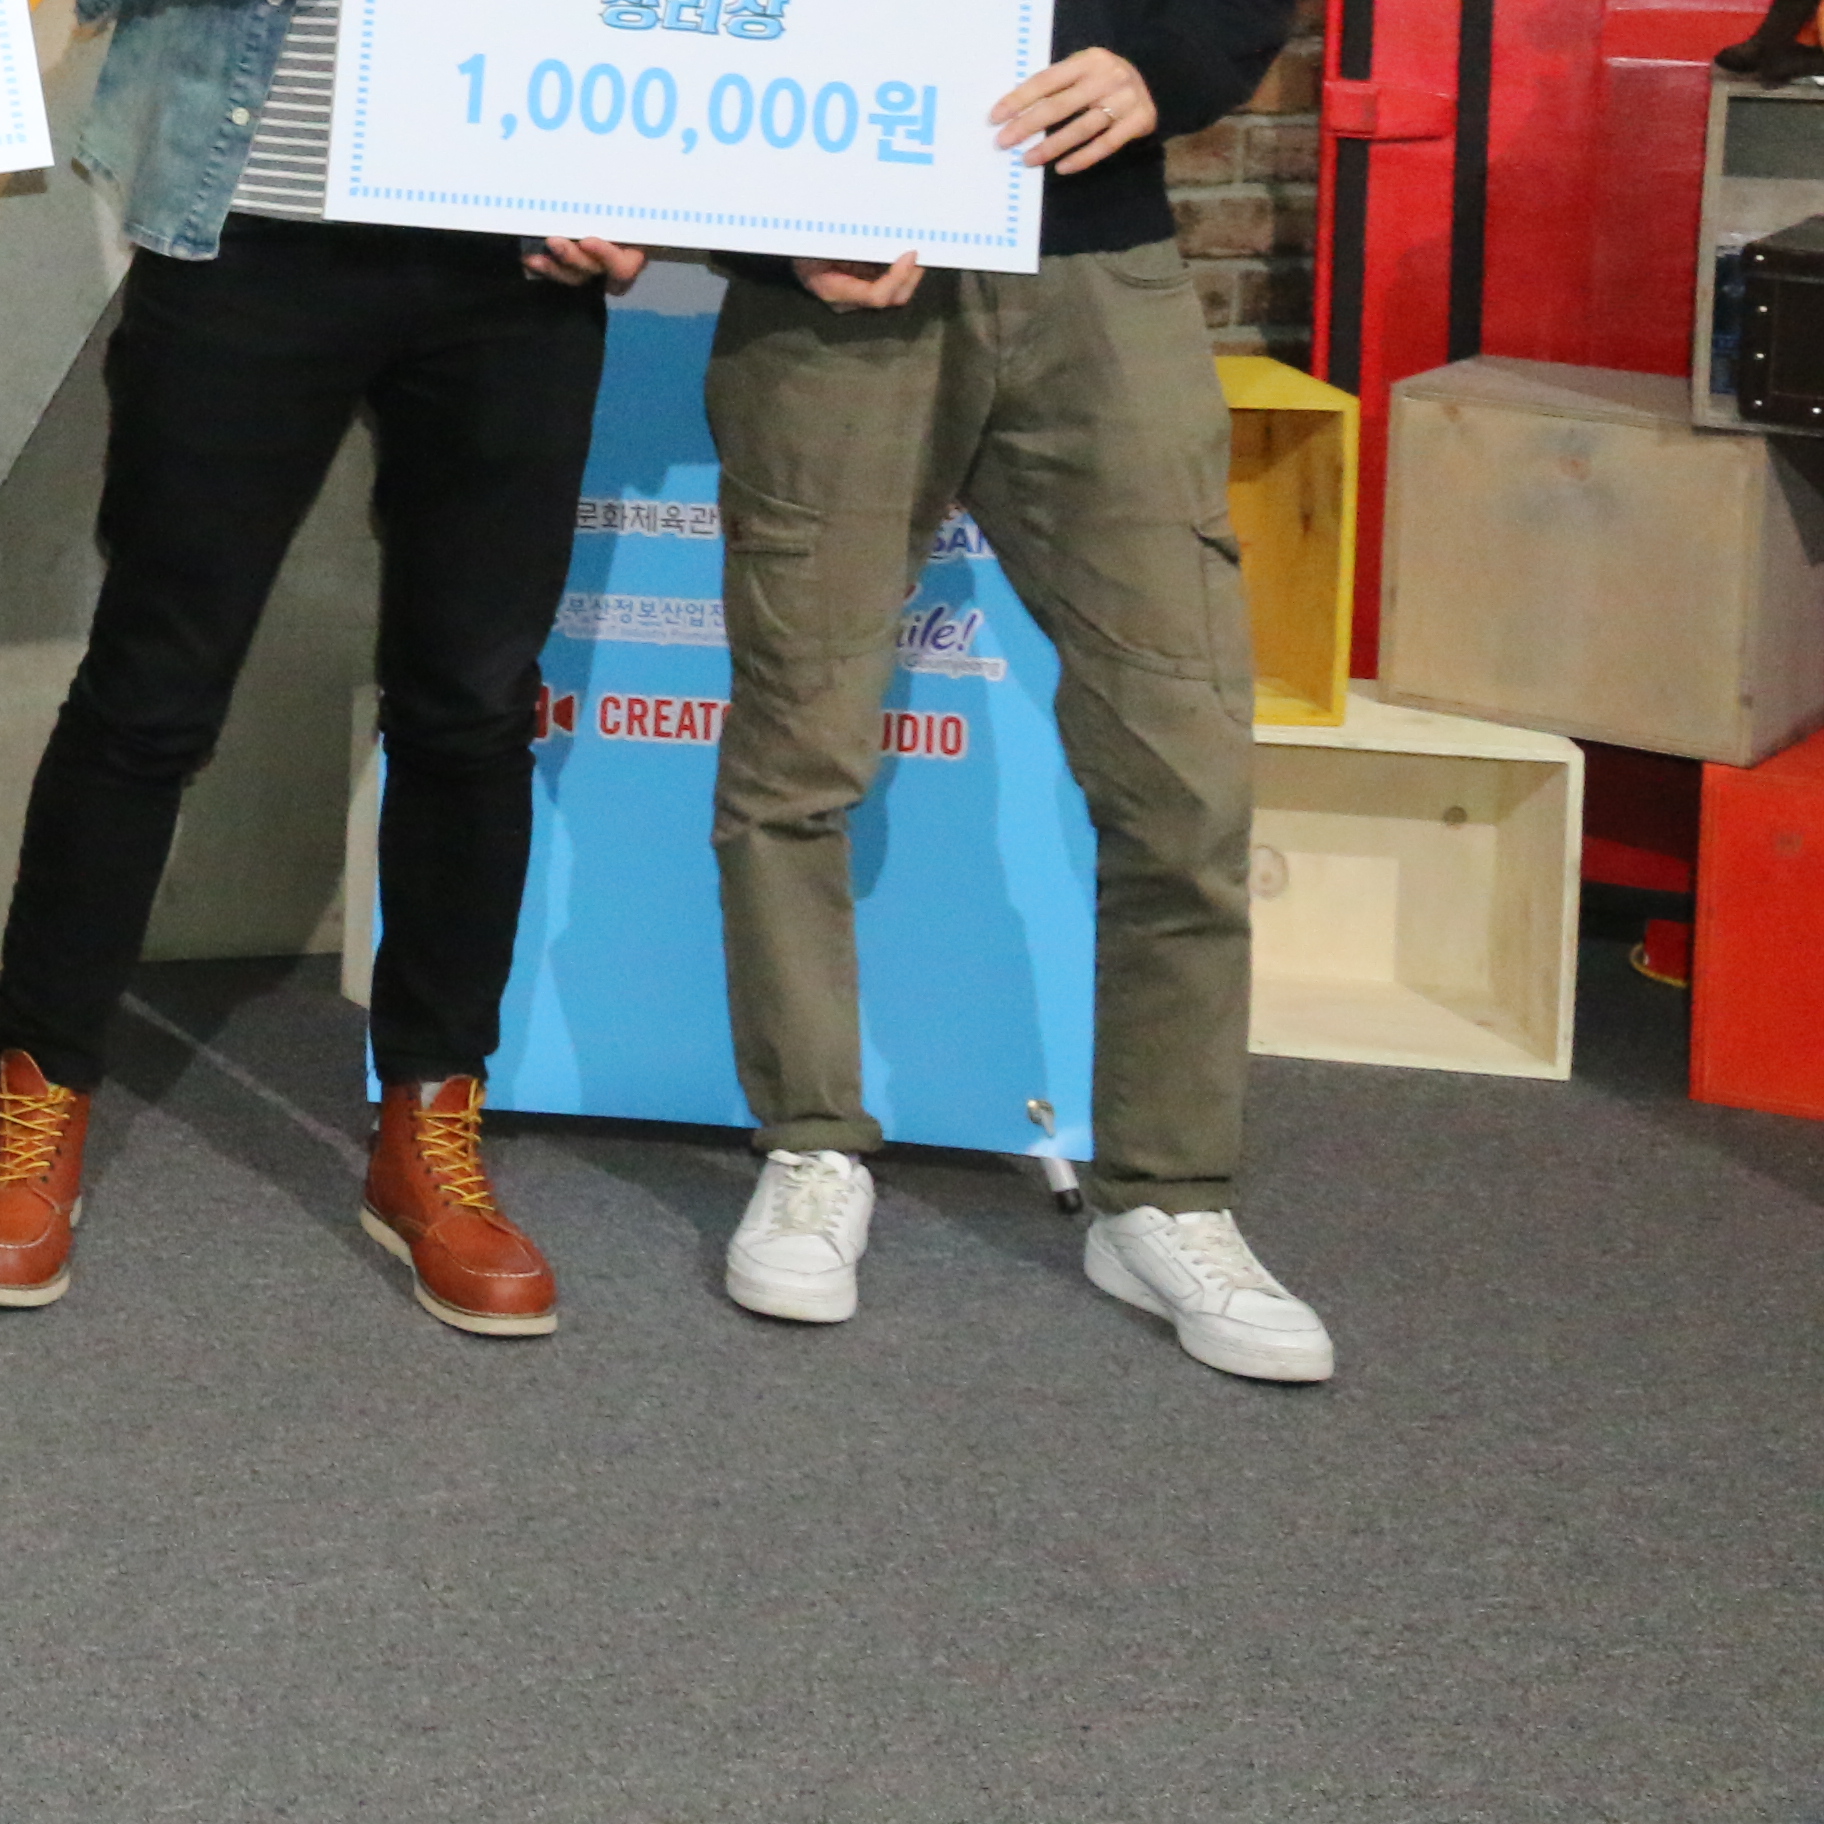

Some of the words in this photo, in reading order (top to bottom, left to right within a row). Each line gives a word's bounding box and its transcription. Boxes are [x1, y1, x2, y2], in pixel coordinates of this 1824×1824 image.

[458, 54, 937, 165] 1,000,000원
[578, 501, 717, 536] 문화체육관
[600, 696, 732, 741] CREAT
